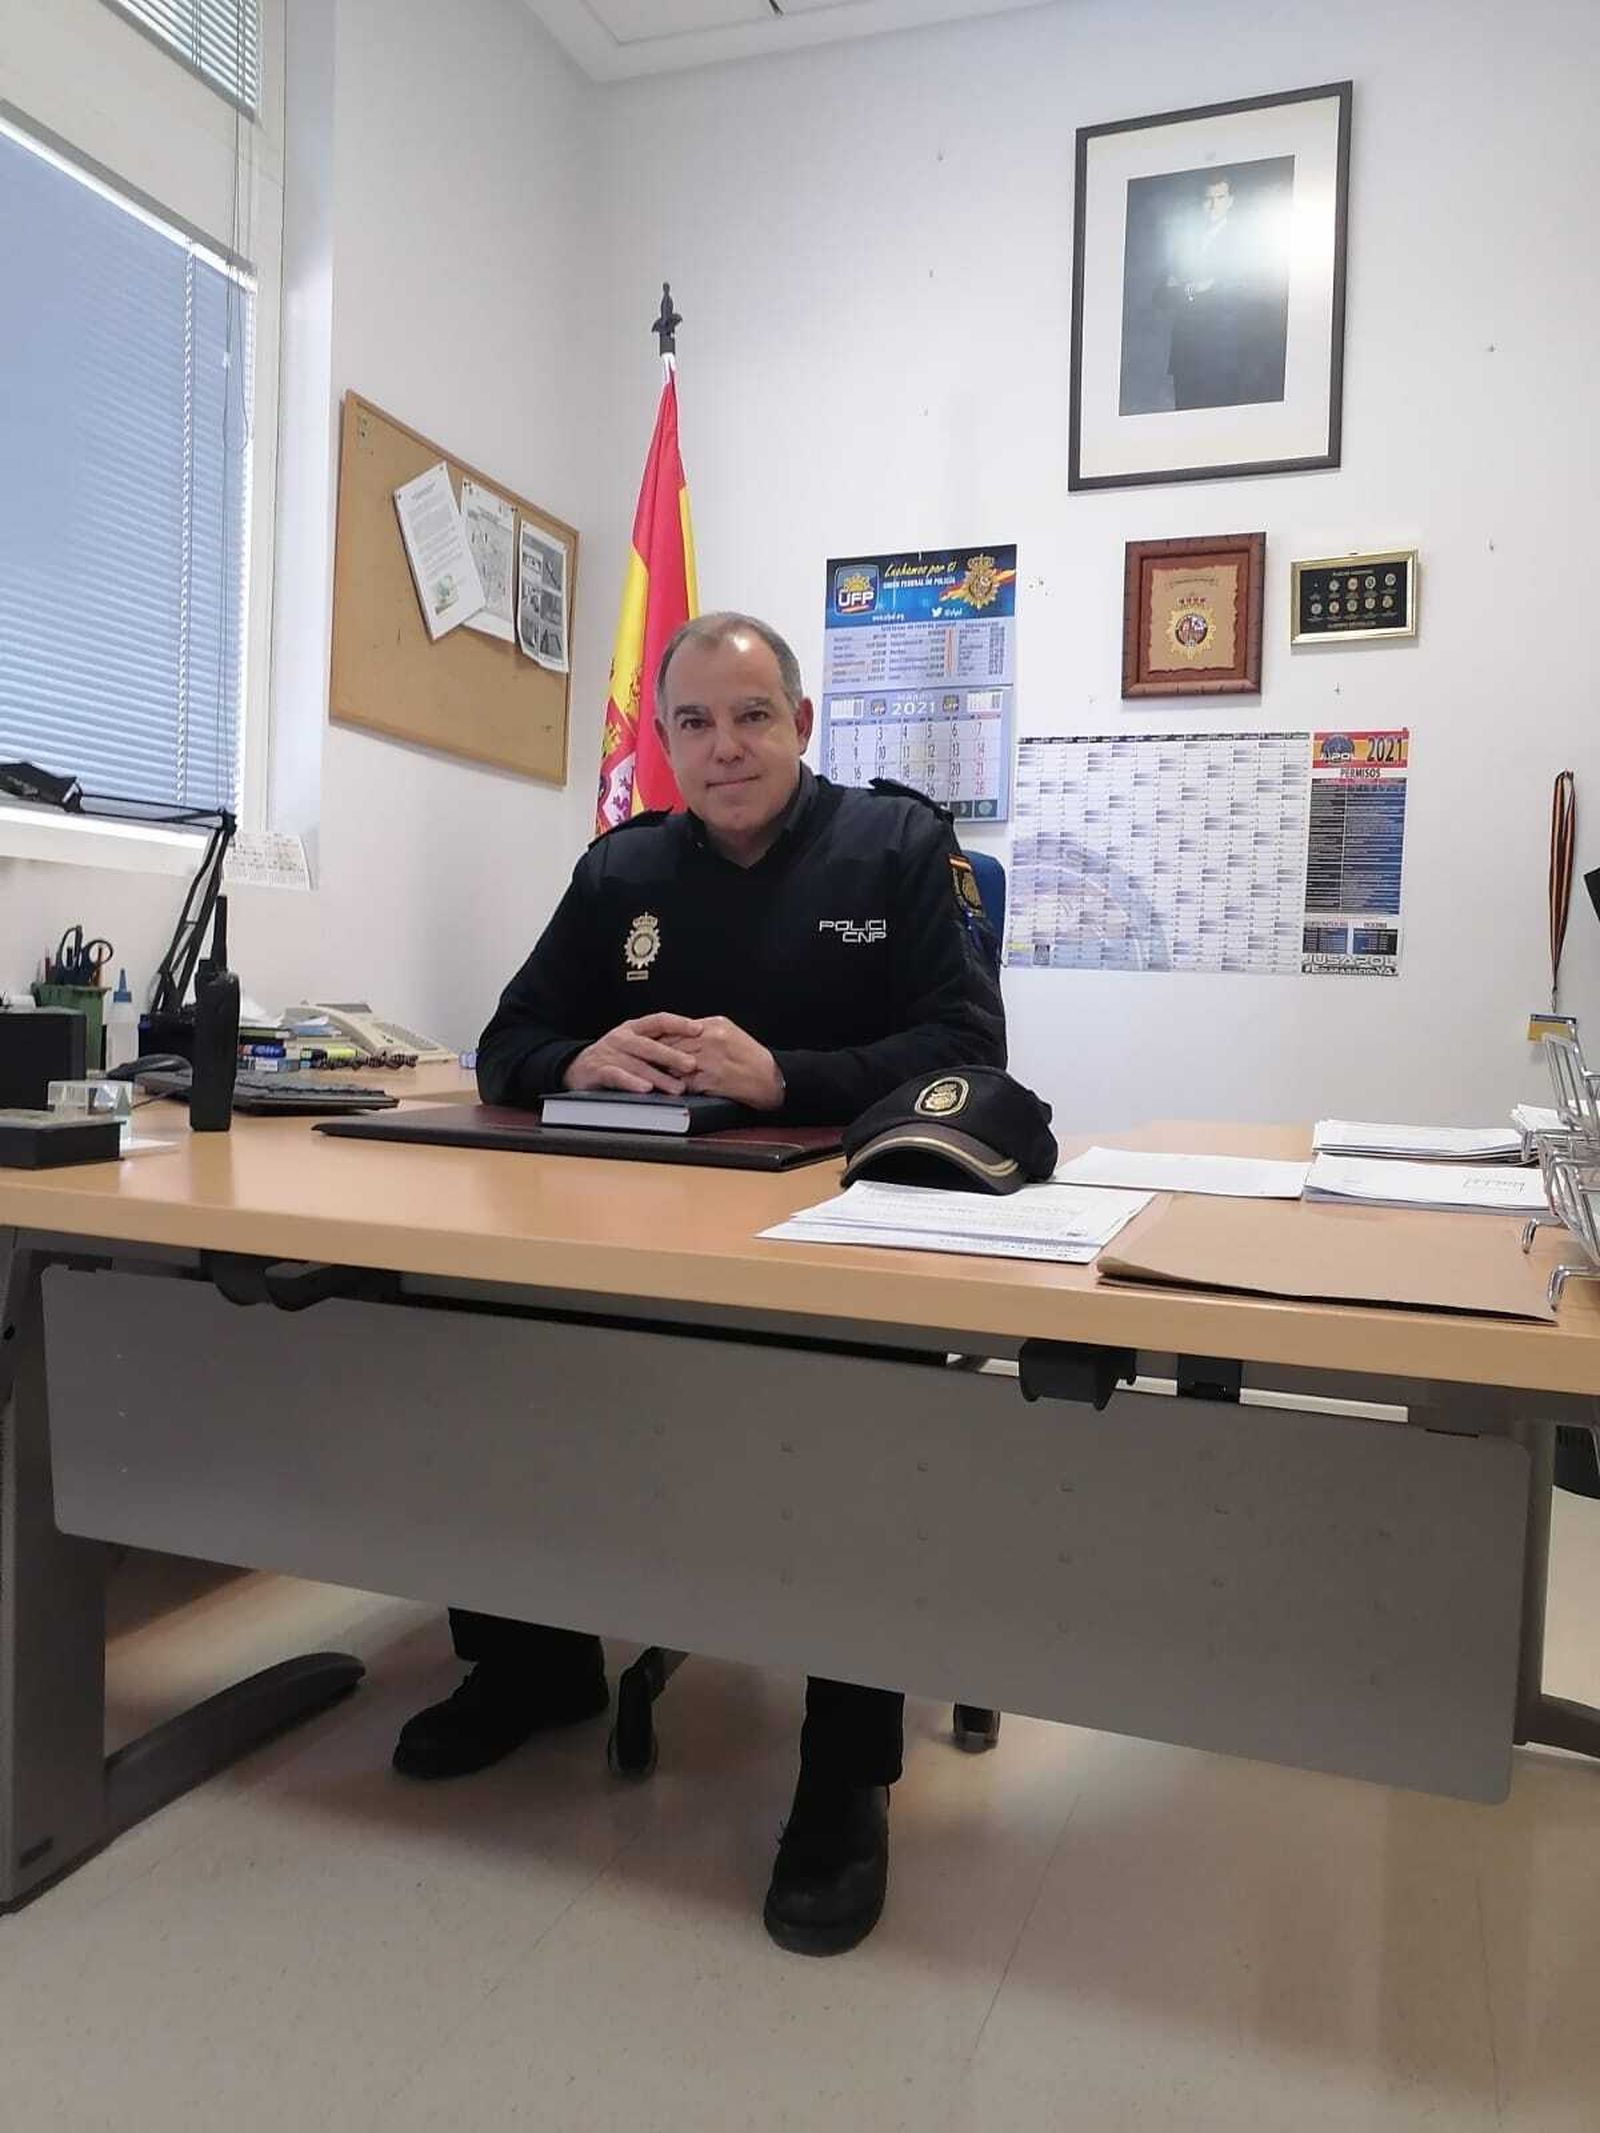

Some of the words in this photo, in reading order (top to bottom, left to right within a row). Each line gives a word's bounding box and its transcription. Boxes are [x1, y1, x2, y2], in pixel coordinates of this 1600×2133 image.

[839, 591, 874, 606] UFP
[891, 702, 935, 716] 2021
[927, 744, 936, 758] 12
[1366, 737, 1403, 763] 2021
[951, 762, 960, 777] 20
[1340, 767, 1381, 778] PERMISOS
[842, 931, 887, 943] CNP
